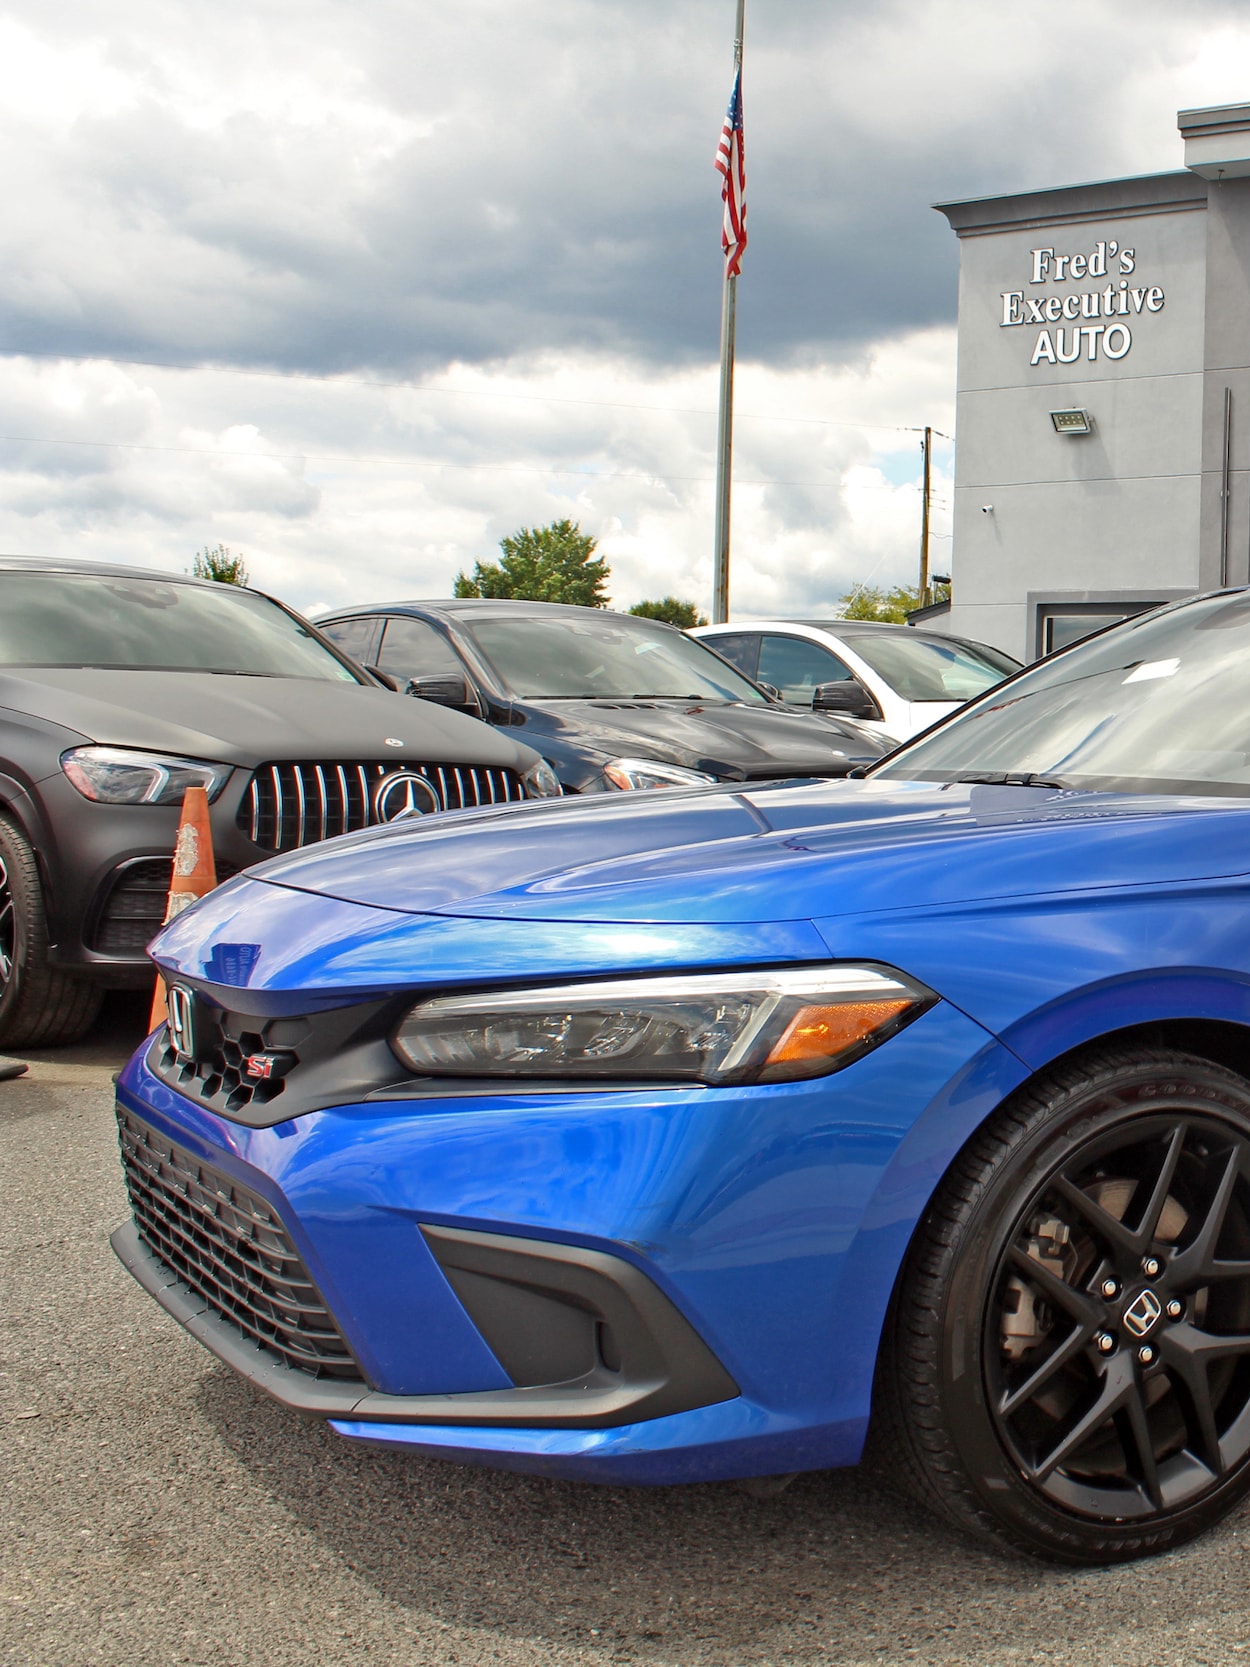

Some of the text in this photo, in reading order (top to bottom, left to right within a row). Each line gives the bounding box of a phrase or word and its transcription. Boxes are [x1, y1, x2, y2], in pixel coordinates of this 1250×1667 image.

[1029, 240, 1136, 284] Fred's
[999, 280, 1165, 328] Executive
[1029, 322, 1133, 366] AUTO
[247, 1055, 274, 1079] Si
